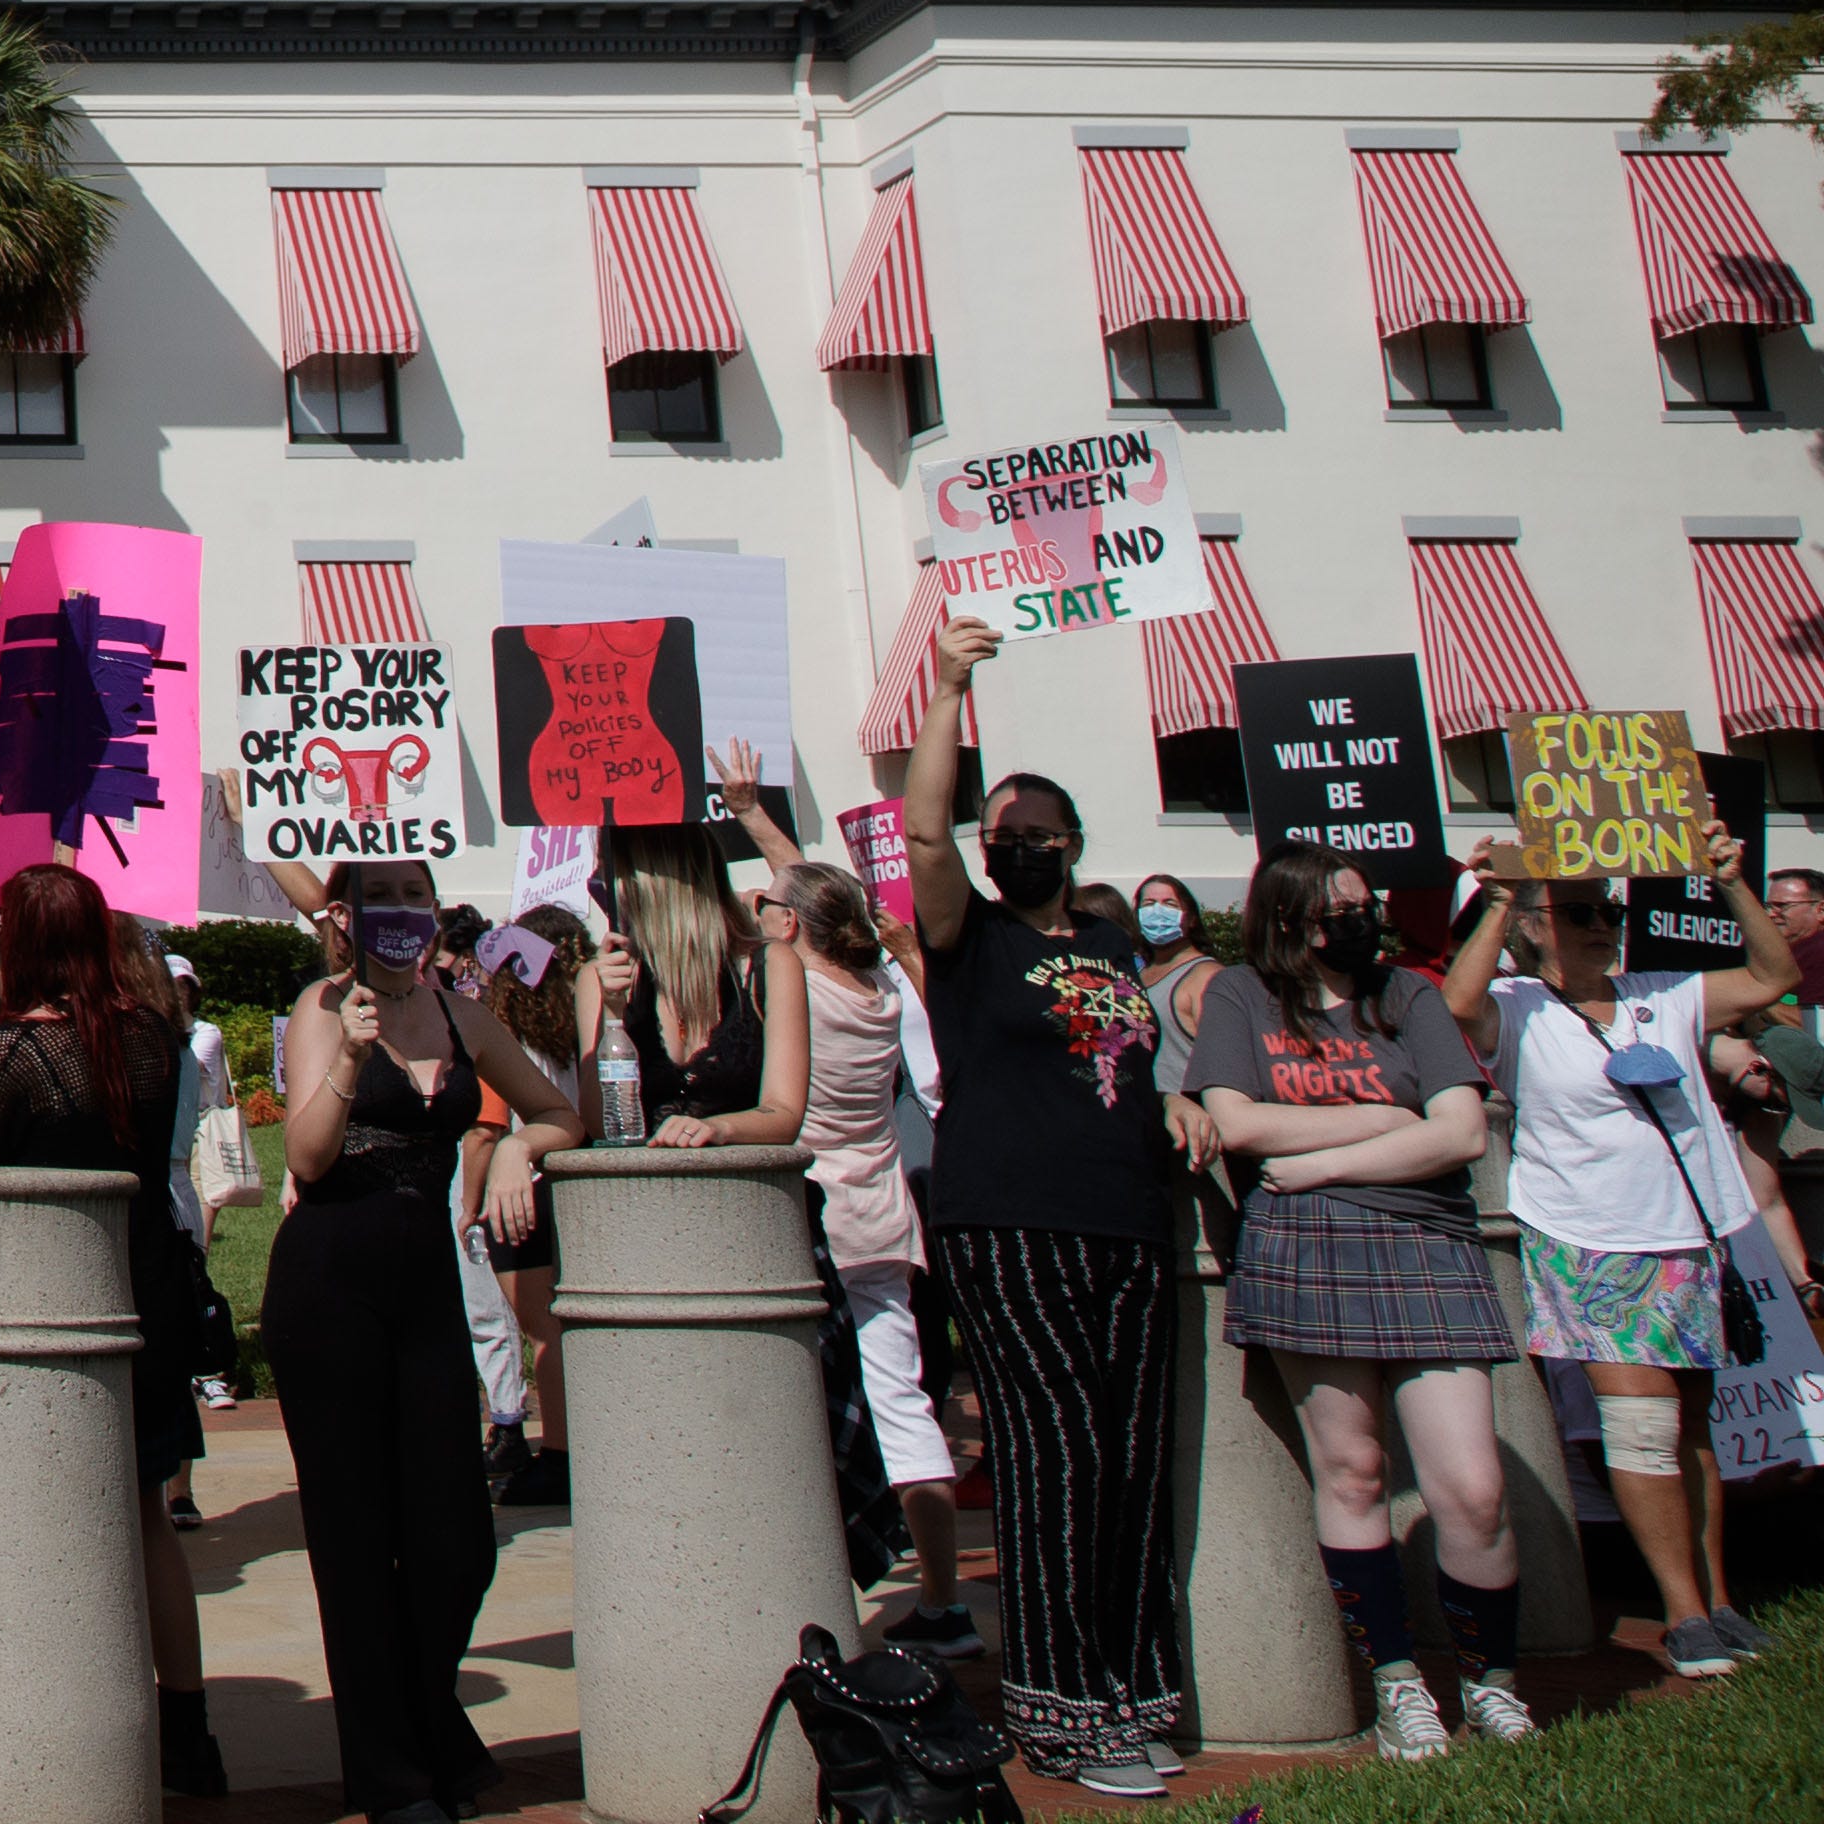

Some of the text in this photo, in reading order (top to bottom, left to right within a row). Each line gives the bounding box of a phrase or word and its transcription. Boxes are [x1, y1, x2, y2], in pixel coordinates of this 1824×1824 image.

[962, 429, 1153, 492] SEPARATION
[986, 471, 1128, 526] BETWEEN
[937, 525, 1165, 596] UTERUS AND
[1013, 577, 1132, 632] STATE
[240, 646, 445, 696] KEEP YOUR
[561, 661, 629, 686] KEEP
[290, 689, 451, 732] ROSARY
[567, 688, 630, 713] YOUR
[1309, 698, 1355, 726] WE
[240, 729, 298, 765] OFF
[569, 734, 625, 761] OFF
[1274, 737, 1400, 771] WILL NOT
[1531, 713, 1662, 771] FOCUS
[247, 768, 308, 808] MY
[1326, 782, 1364, 810] BE
[1521, 769, 1697, 819] ON THE
[267, 817, 456, 860] OVARIES
[527, 826, 583, 878] SHE
[864, 834, 906, 861] LEGA
[1284, 821, 1415, 852] SILENCED
[1552, 818, 1693, 877] BORN
[1685, 875, 1713, 902] BE
[377, 926, 408, 938] BANS
[377, 935, 423, 949] OFF OUR
[1648, 910, 1744, 948] SILENCED
[1270, 1061, 1395, 1104] RIGHTS
